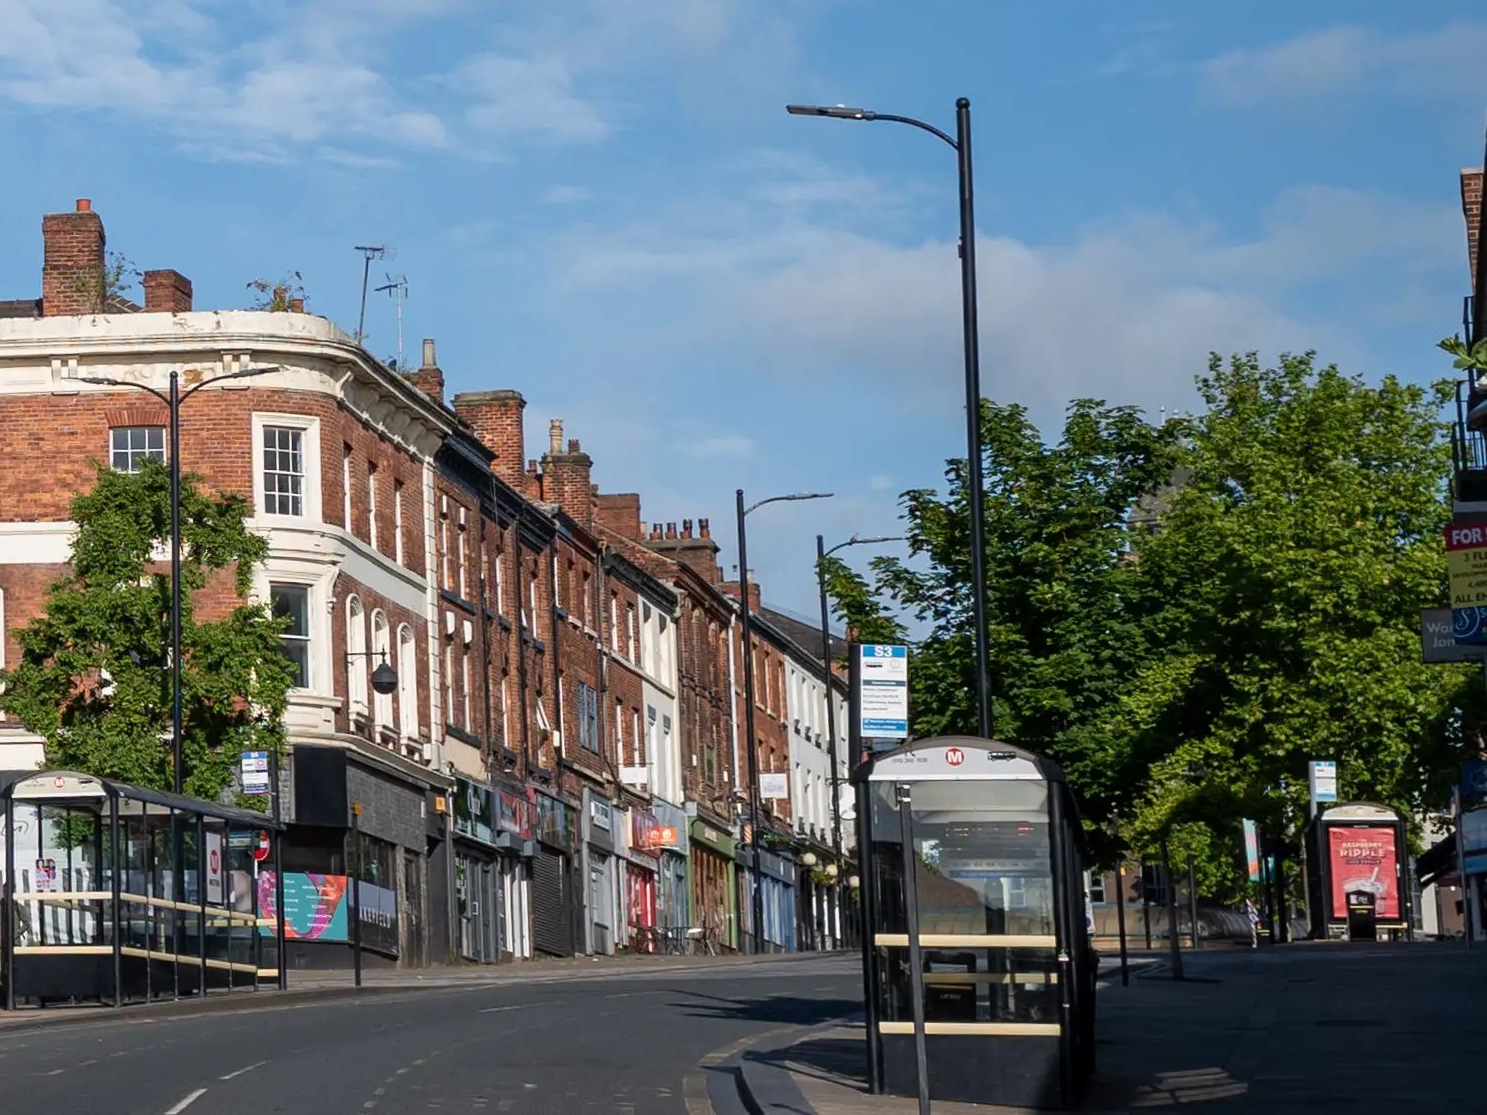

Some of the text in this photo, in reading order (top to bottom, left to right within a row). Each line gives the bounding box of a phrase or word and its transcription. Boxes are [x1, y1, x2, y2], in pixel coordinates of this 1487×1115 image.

[1452, 528, 1483, 545] FOR
[1454, 594, 1474, 604] ALL
[874, 645, 893, 658] S3
[1339, 848, 1386, 857] RIPPLE
[359, 905, 392, 929] AKEFIELD
